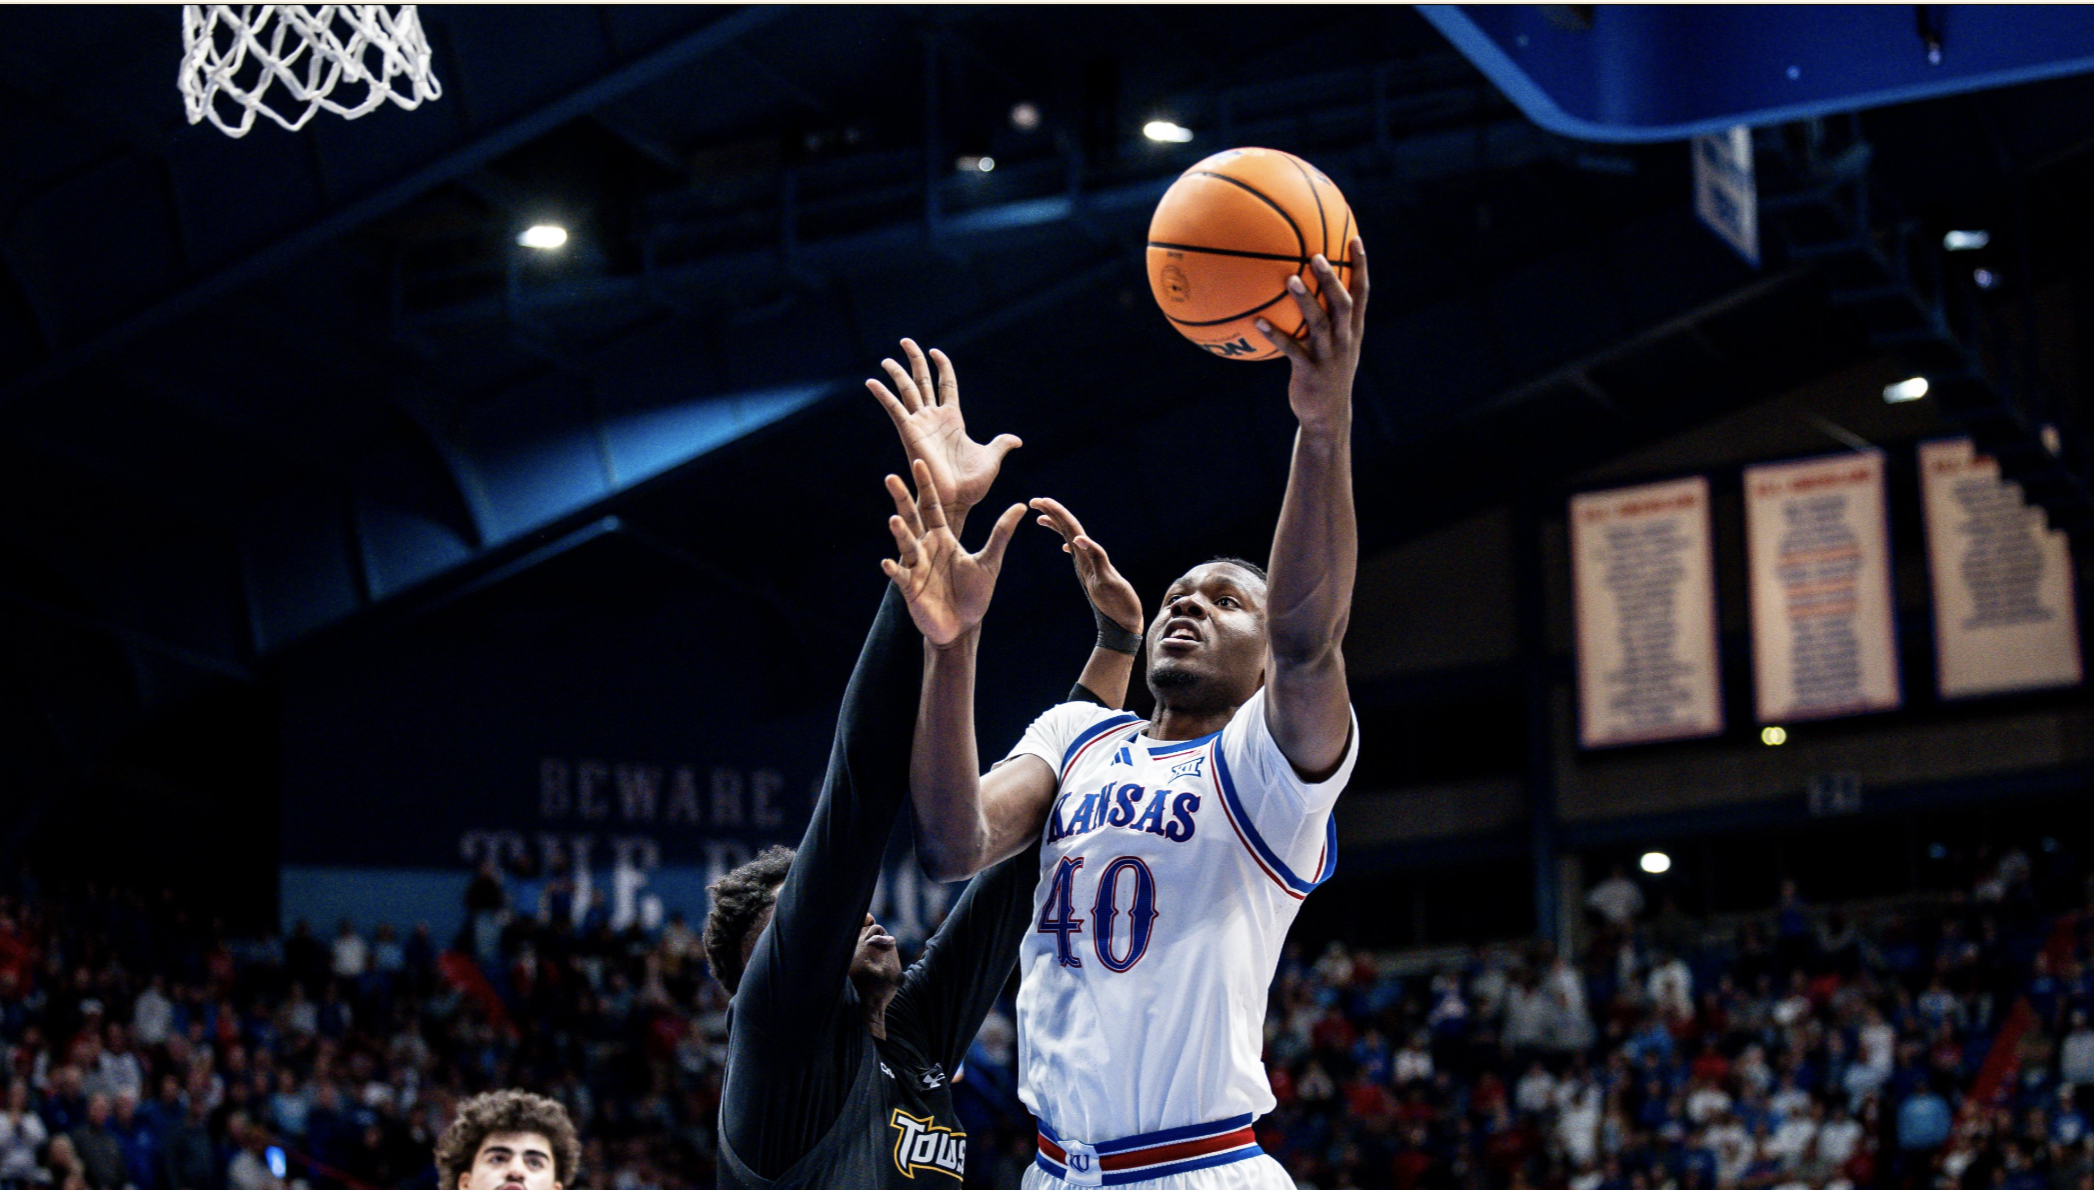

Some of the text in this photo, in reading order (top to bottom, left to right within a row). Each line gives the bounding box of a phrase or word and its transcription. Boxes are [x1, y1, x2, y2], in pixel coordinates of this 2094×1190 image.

[538, 757, 786, 829] BEWARE
[1047, 781, 1202, 843] KANSAS
[1038, 856, 1159, 973] 40
